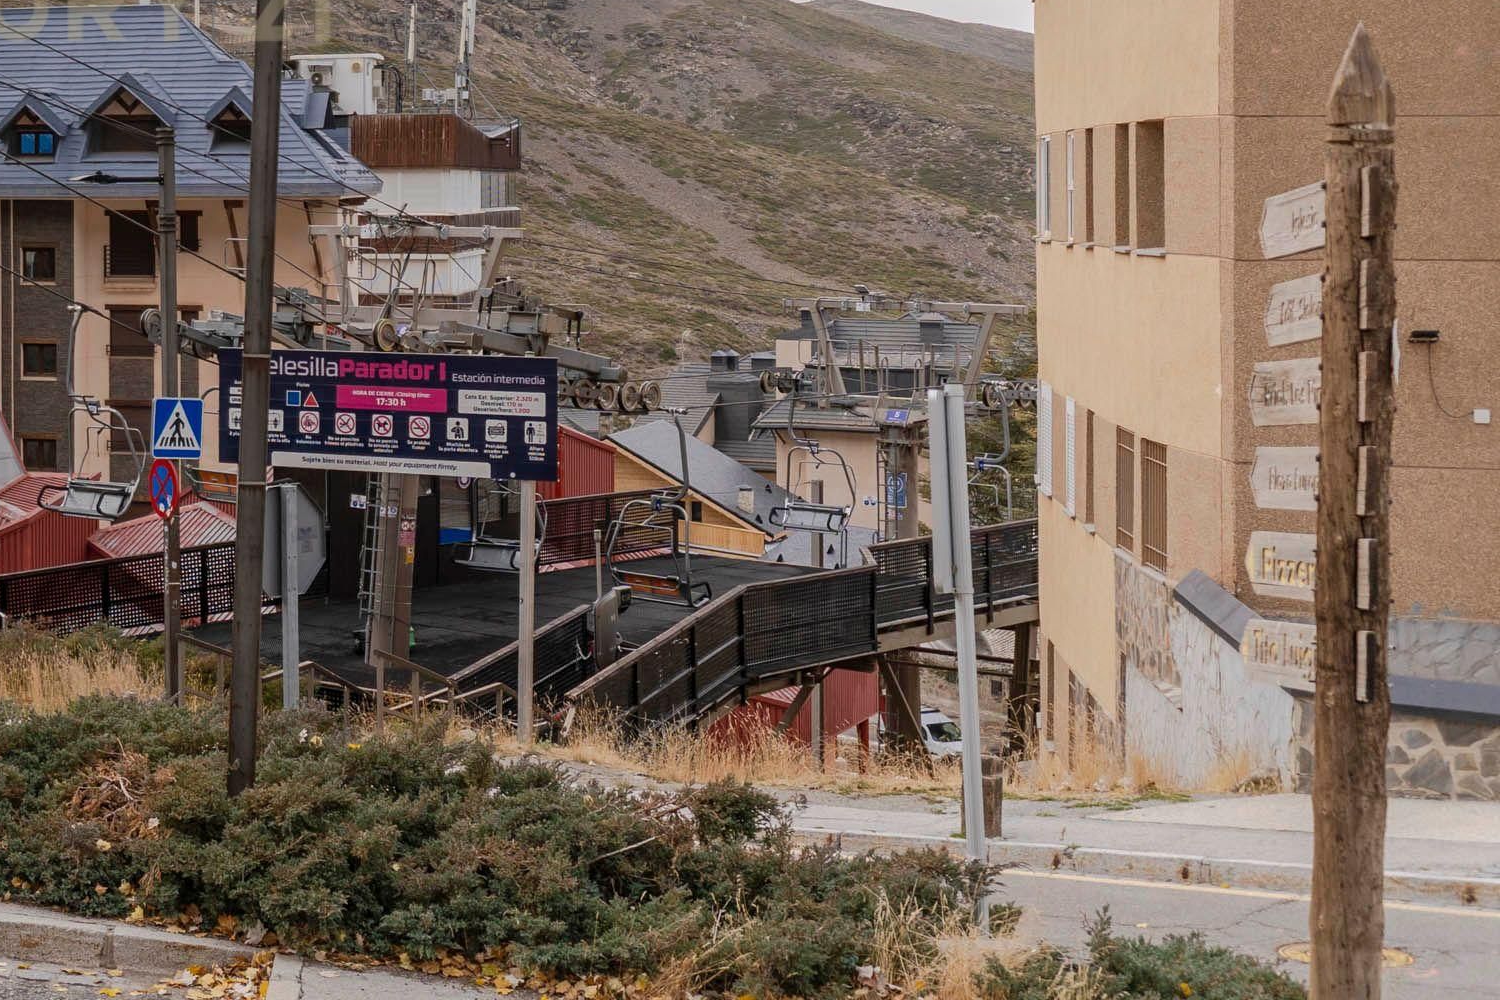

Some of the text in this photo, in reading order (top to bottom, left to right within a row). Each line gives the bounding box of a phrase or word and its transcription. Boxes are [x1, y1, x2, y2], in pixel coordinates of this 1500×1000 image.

[451, 373, 546, 385] Estación intermedia
[375, 397, 407, 406] 17:30 h
[1260, 545, 1317, 588] Pizzer
